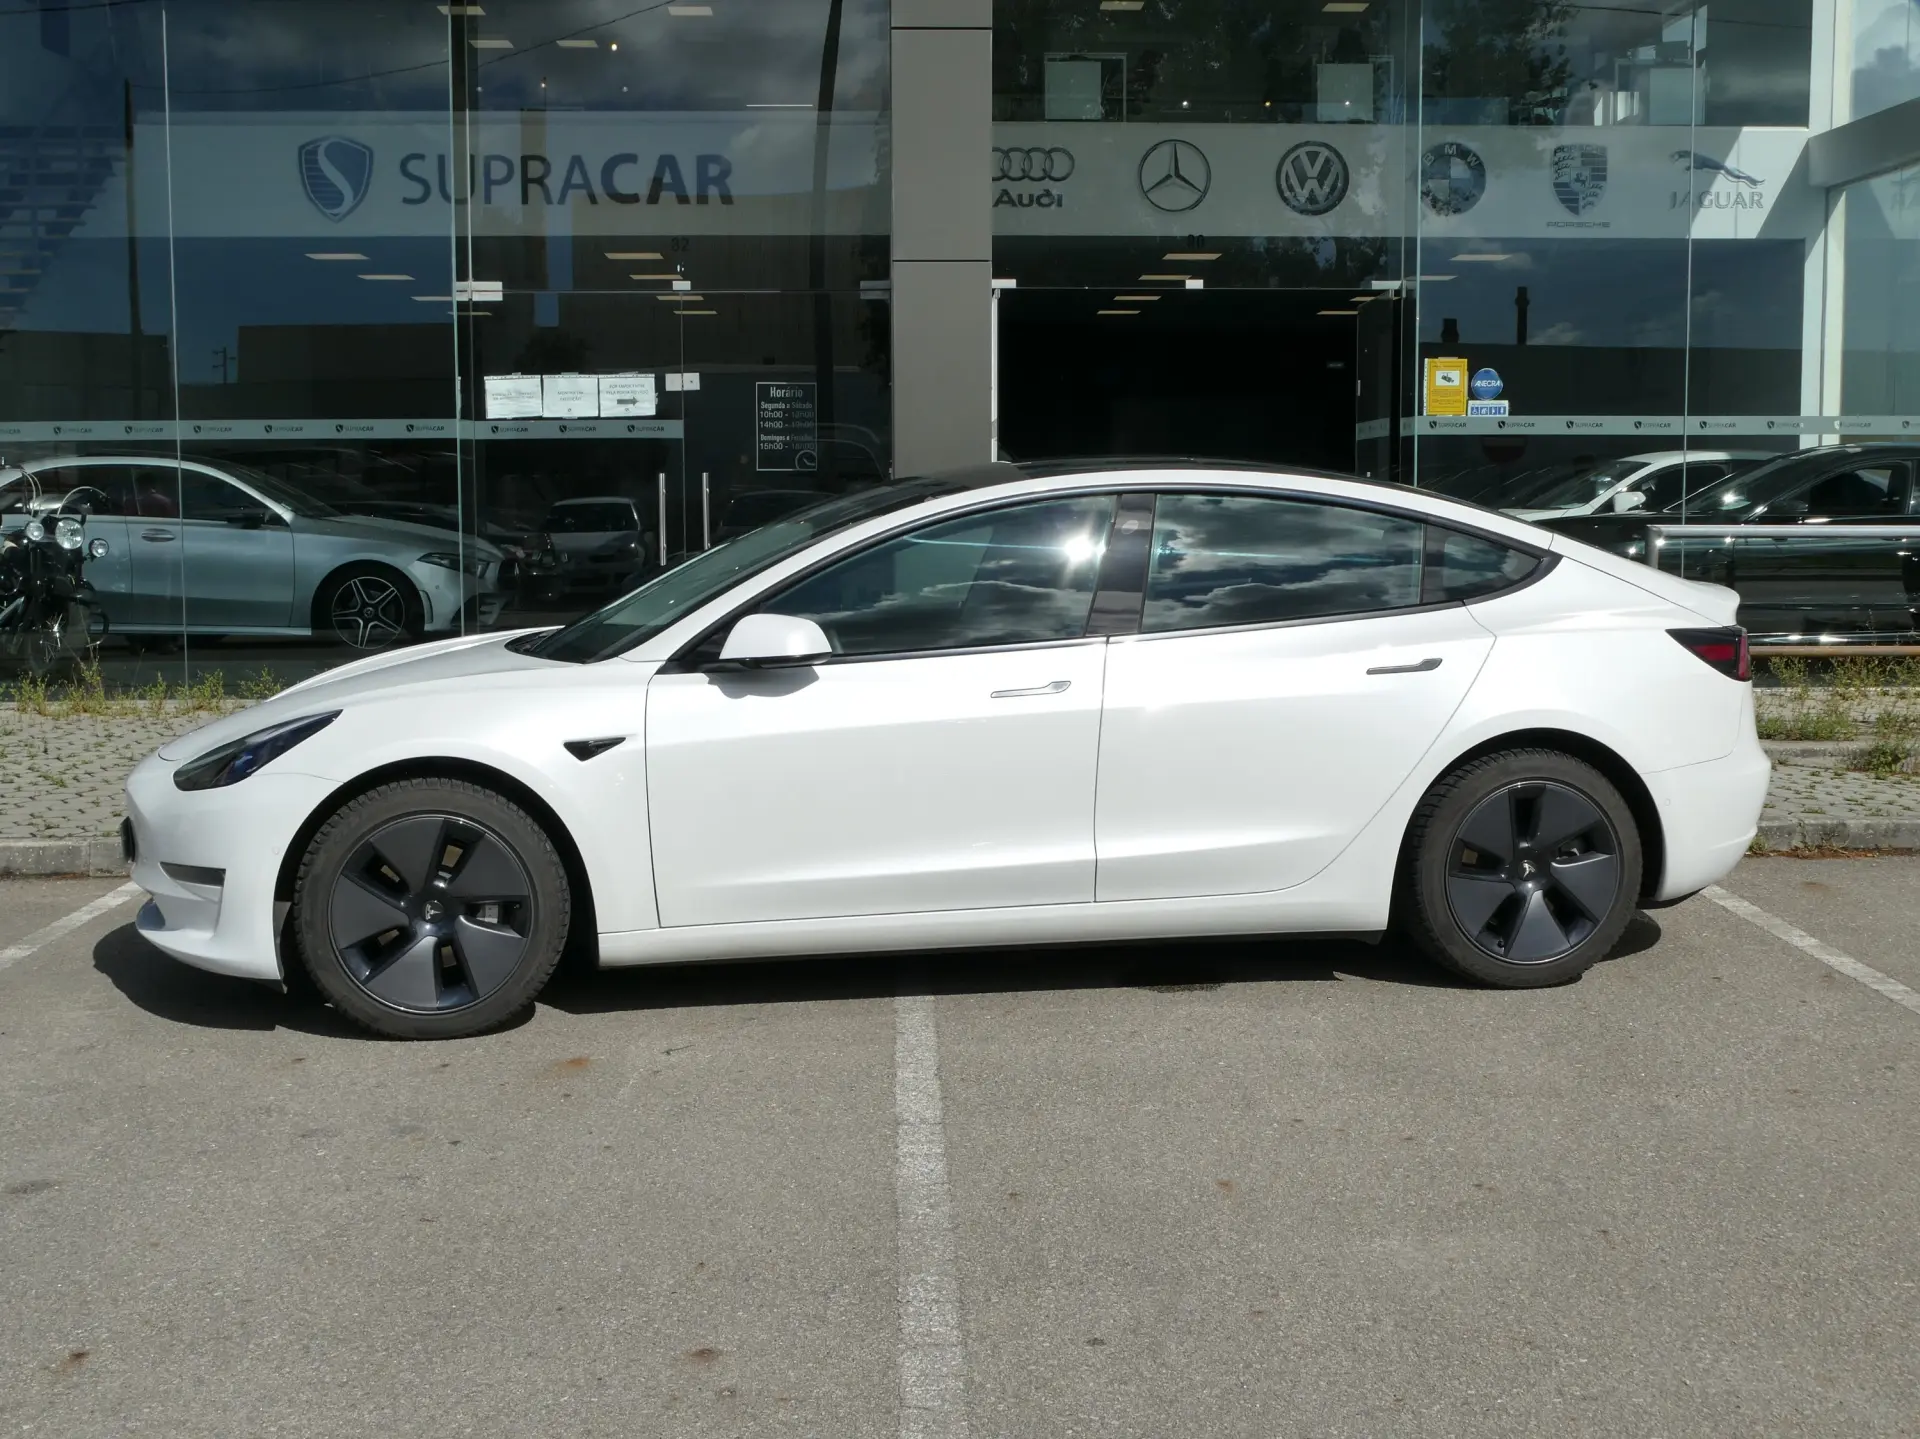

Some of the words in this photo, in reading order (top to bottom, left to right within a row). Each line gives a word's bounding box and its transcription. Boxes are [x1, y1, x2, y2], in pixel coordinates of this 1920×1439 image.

[1422, 143, 1481, 167] BMW
[399, 152, 735, 206] SUPRACAR
[993, 188, 1063, 208] Audi
[1669, 190, 1765, 210] JAGUAR
[1546, 221, 1611, 229] PORSCHE
[1474, 379, 1500, 387] ANECRA
[770, 386, 803, 398] Horário
[760, 401, 786, 410] Segunda
[760, 442, 783, 450] 15h00
